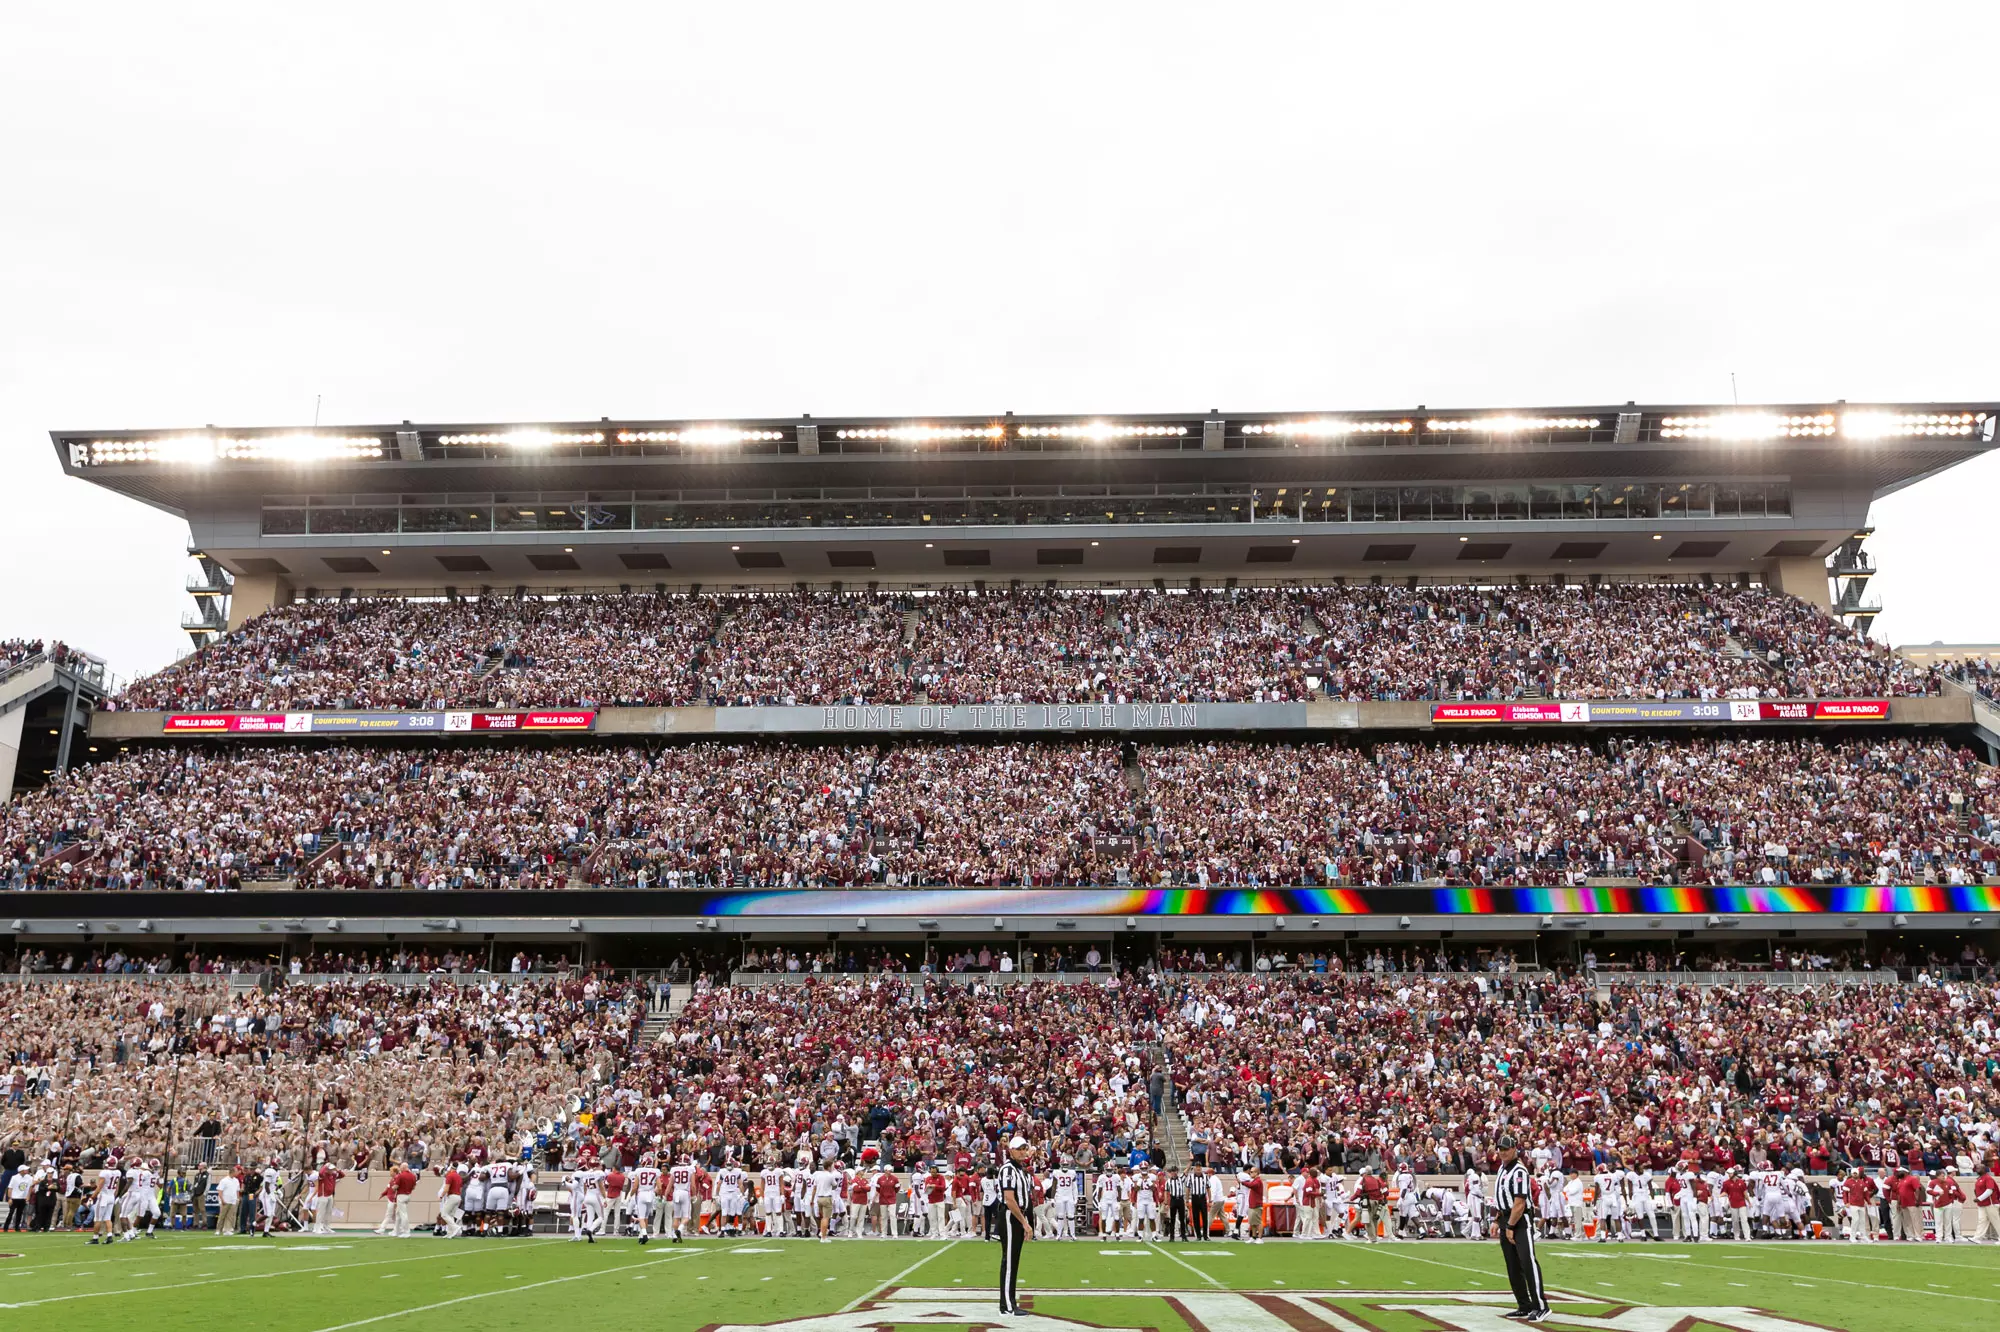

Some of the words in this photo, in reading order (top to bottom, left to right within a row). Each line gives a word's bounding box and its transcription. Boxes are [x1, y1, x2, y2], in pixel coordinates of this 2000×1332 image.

[1512, 712, 1544, 720] CRIMSON
[1591, 707, 1638, 715] COUNTDOWN
[1692, 705, 1720, 716] 3:08
[1779, 710, 1808, 718] AGGIES
[174, 719, 200, 727] WELLS
[200, 719, 226, 727] FARGO
[408, 716, 435, 727] 3:08
[532, 716, 559, 724] WELLS
[559, 716, 585, 724] FARGO
[822, 706, 902, 730] HOME
[918, 706, 952, 729] OF
[969, 705, 1026, 729] THE
[1043, 705, 1116, 728] 12TH
[1133, 705, 1197, 728] MAN
[239, 722, 269, 730] CRIMSON
[489, 720, 517, 728] AGGIES
[1871, 1149, 1881, 1161] 12
[1886, 1152, 1896, 1162] 12
[491, 1166, 507, 1178] 73
[673, 1170, 689, 1184] 88
[584, 1178, 597, 1190] 45
[640, 1172, 657, 1186] 87
[724, 1175, 736, 1186] 40
[766, 1175, 777, 1186] 81
[1059, 1176, 1072, 1187] 33
[1604, 1178, 1612, 1191] 7
[1638, 1179, 1642, 1189] 1
[1763, 1174, 1778, 1187] 47
[1105, 1181, 1113, 1191] 11
